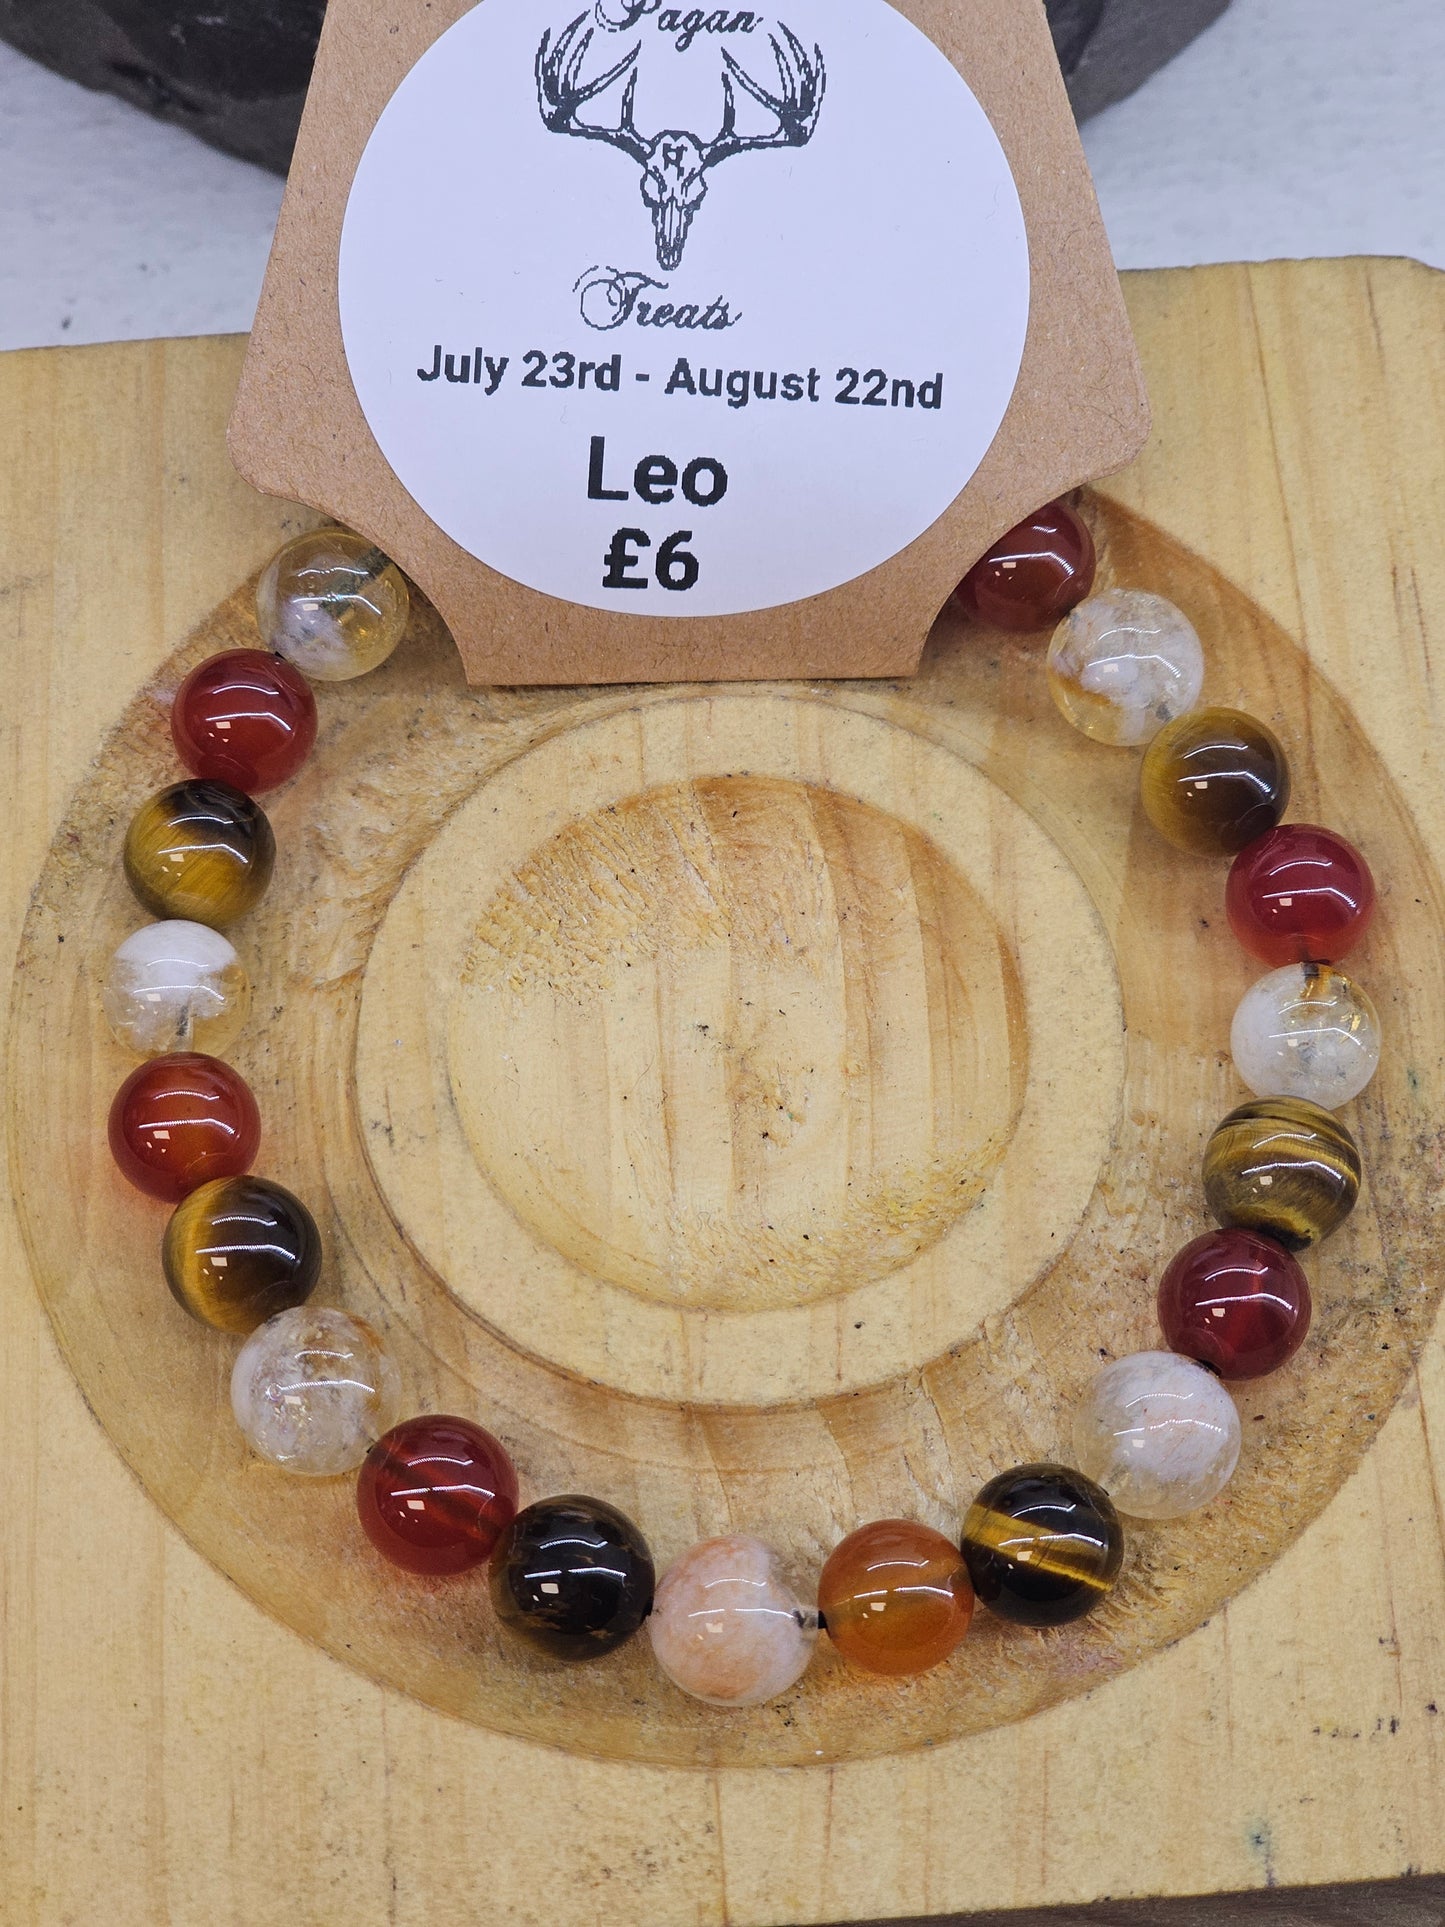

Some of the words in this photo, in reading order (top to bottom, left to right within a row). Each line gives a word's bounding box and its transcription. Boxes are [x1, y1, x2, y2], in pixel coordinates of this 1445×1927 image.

[572, 265, 743, 331] Treats
[416, 344, 510, 396] July
[521, 349, 622, 392] 23rd
[635, 373, 650, 382] -
[664, 357, 821, 410] August
[834, 367, 944, 410] 22nd
[587, 435, 729, 508] Leo
[601, 526, 700, 592] £6
